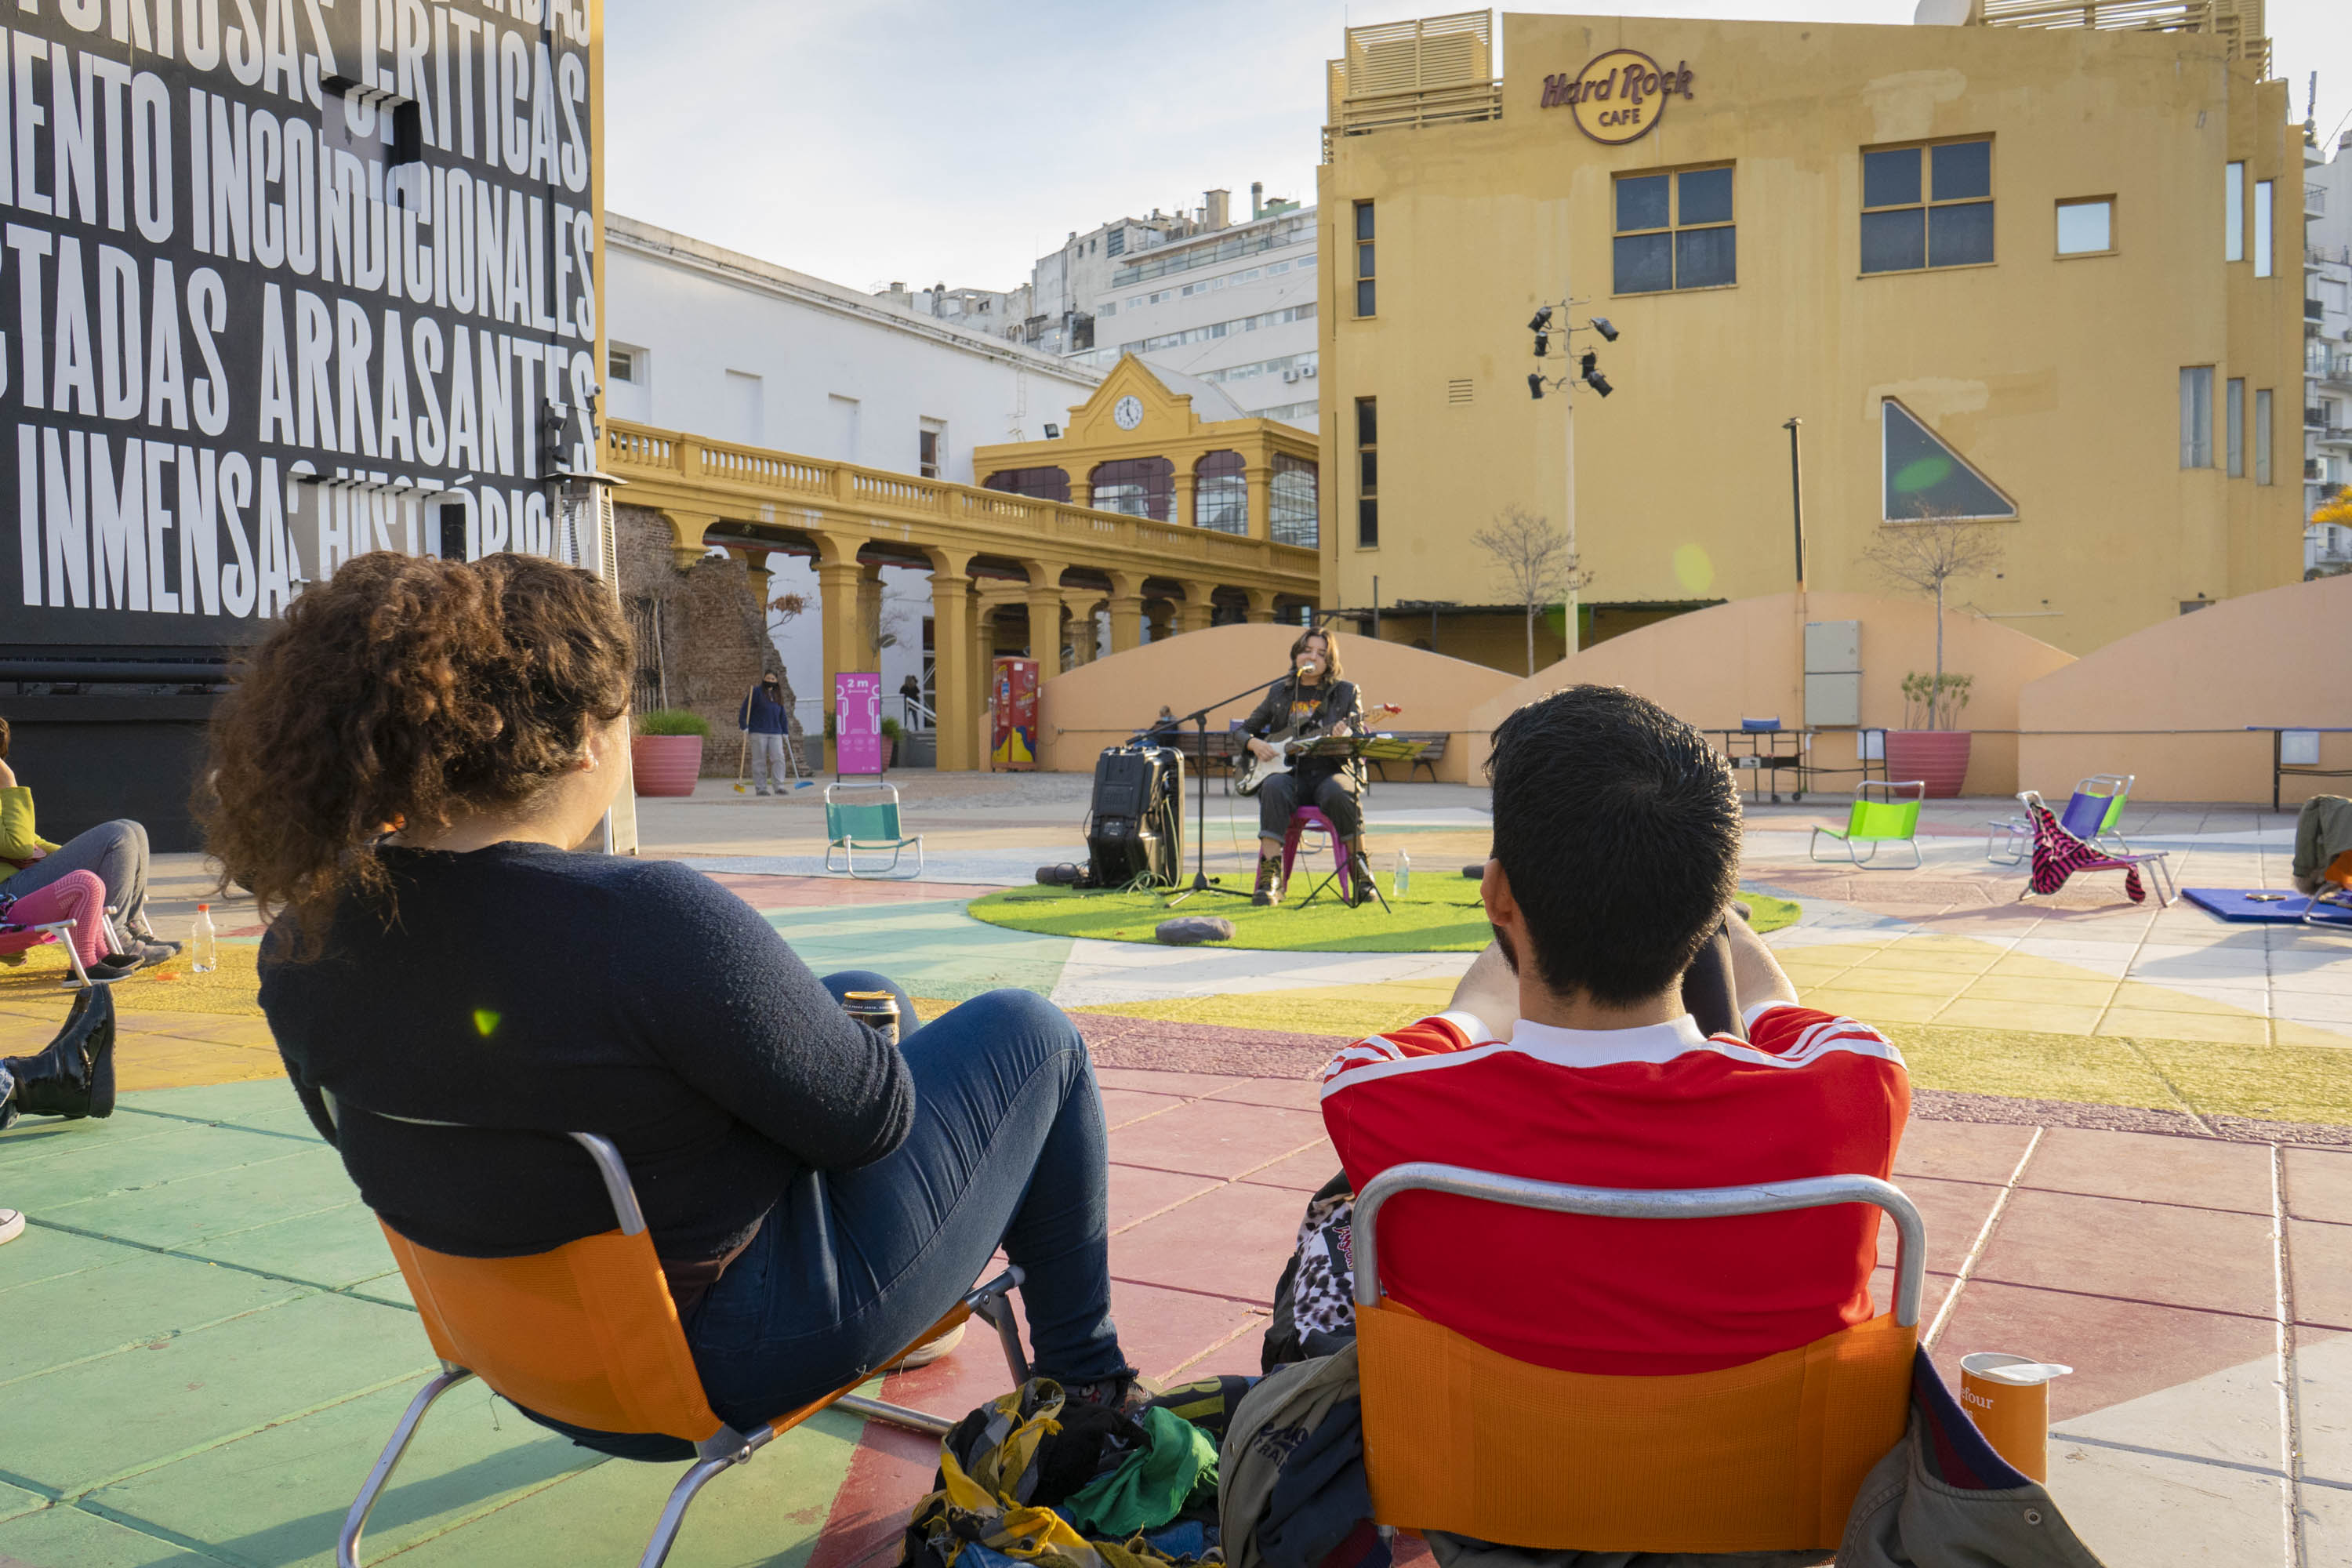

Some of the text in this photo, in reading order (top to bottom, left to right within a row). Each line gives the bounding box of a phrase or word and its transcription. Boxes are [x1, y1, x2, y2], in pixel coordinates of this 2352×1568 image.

[1541, 60, 1693, 108] Hard Rock
[1599, 108, 1641, 127] CAFE
[190, 87, 596, 343] INCONDICIONALES
[0, 222, 230, 437] TADAS
[848, 679, 855, 688] 2
